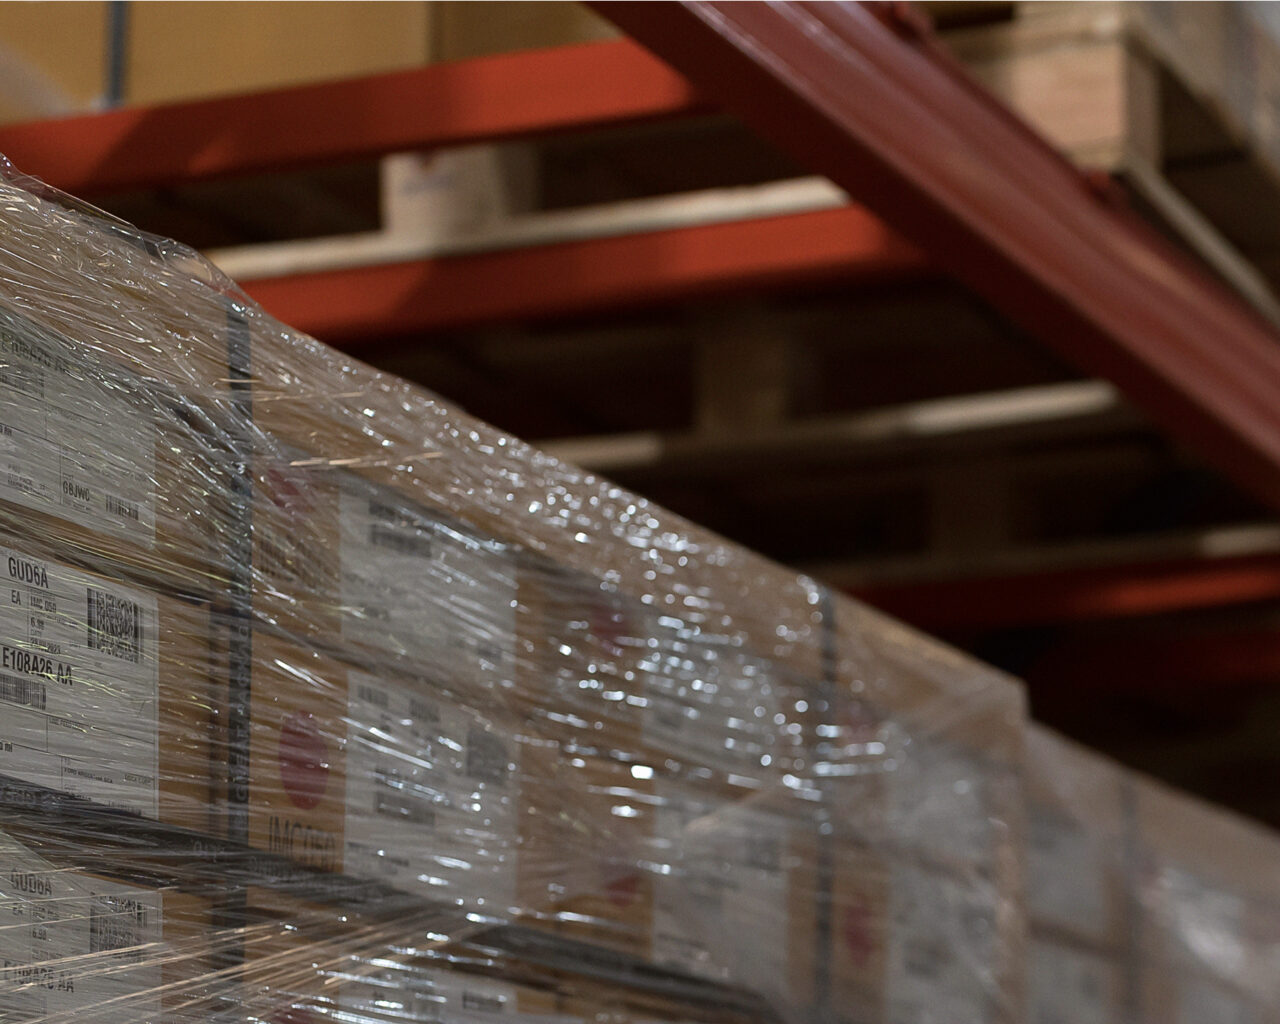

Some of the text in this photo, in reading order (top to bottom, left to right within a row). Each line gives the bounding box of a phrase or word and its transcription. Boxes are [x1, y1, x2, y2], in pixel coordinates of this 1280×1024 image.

[8, 556, 49, 589] GUD6A
[2, 647, 73, 686] E108A26 AA
